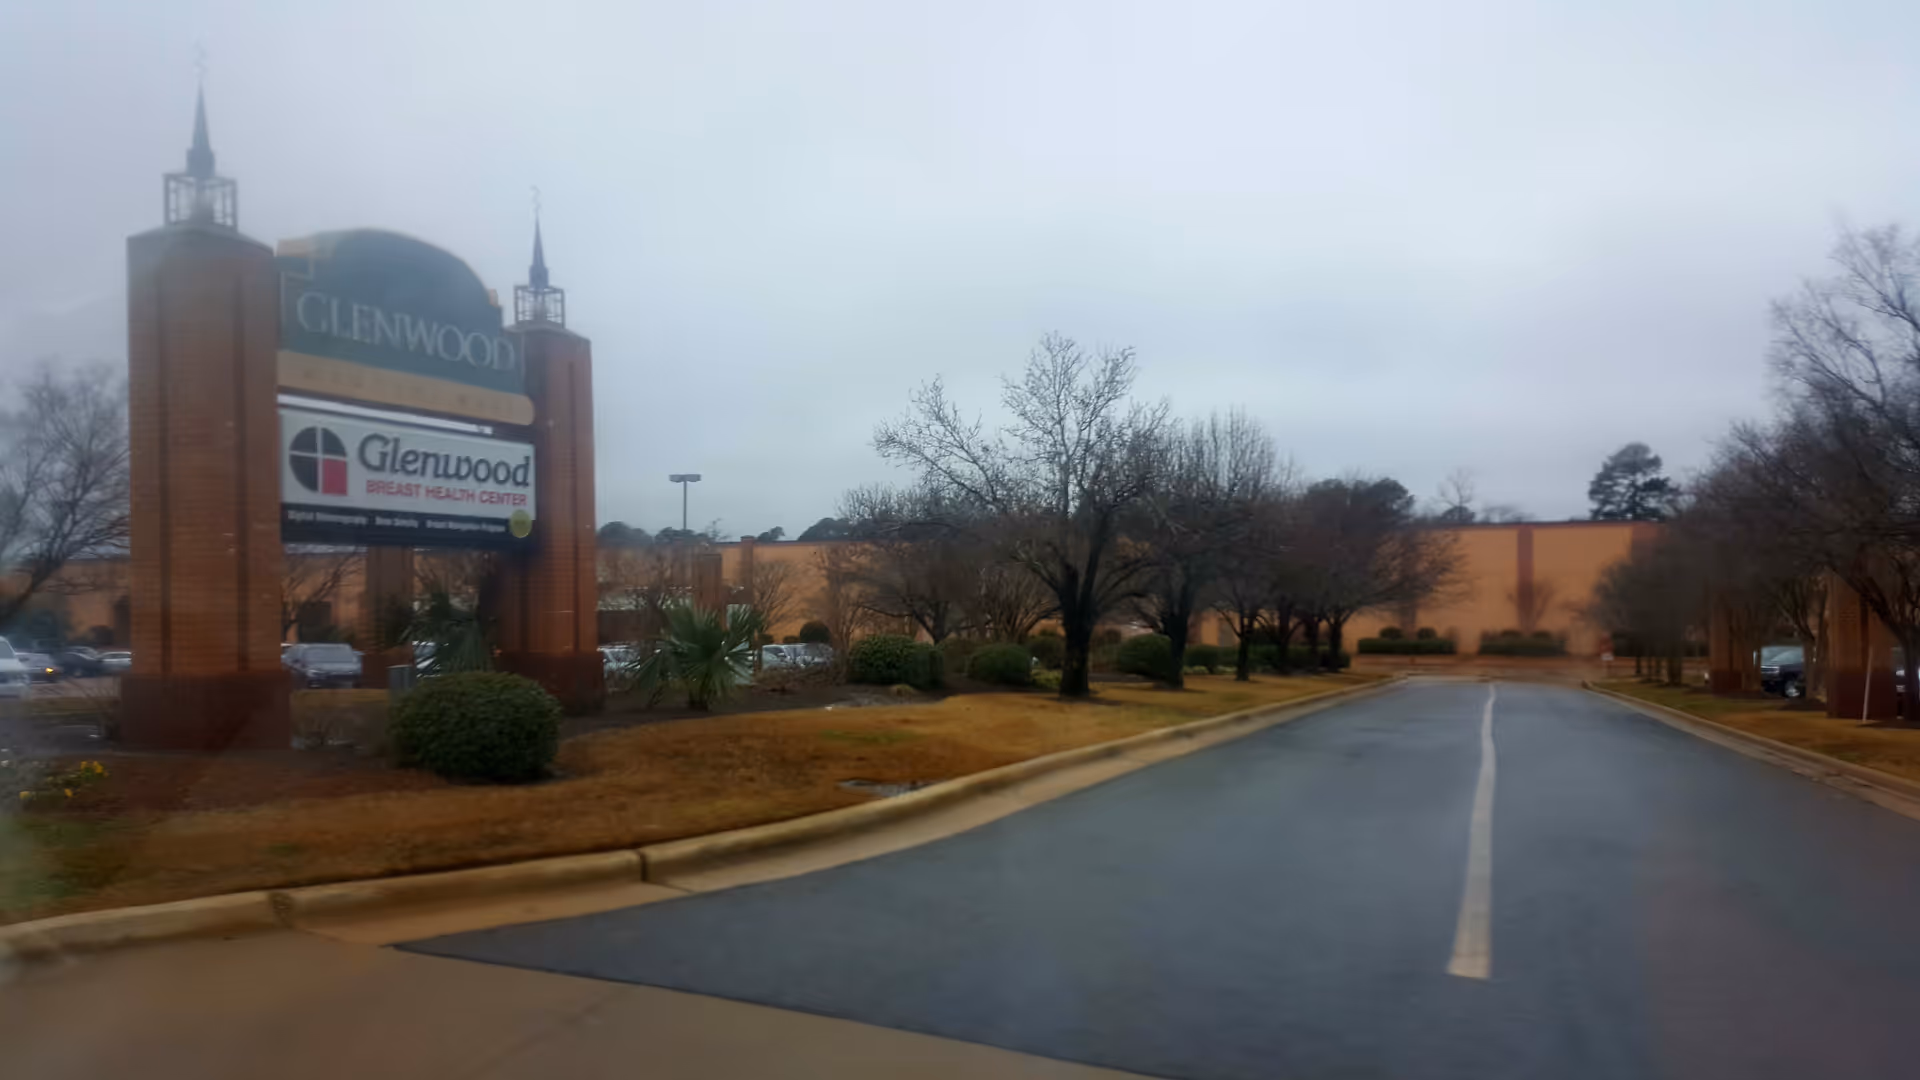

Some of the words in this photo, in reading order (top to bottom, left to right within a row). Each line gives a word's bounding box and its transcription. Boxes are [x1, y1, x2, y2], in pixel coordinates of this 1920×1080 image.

[297, 291, 515, 370] GLENWOOD
[358, 433, 530, 488] Glenwood
[366, 480, 422, 498] BREAST
[425, 486, 476, 503] HEALTH
[480, 490, 527, 506] CENTER
